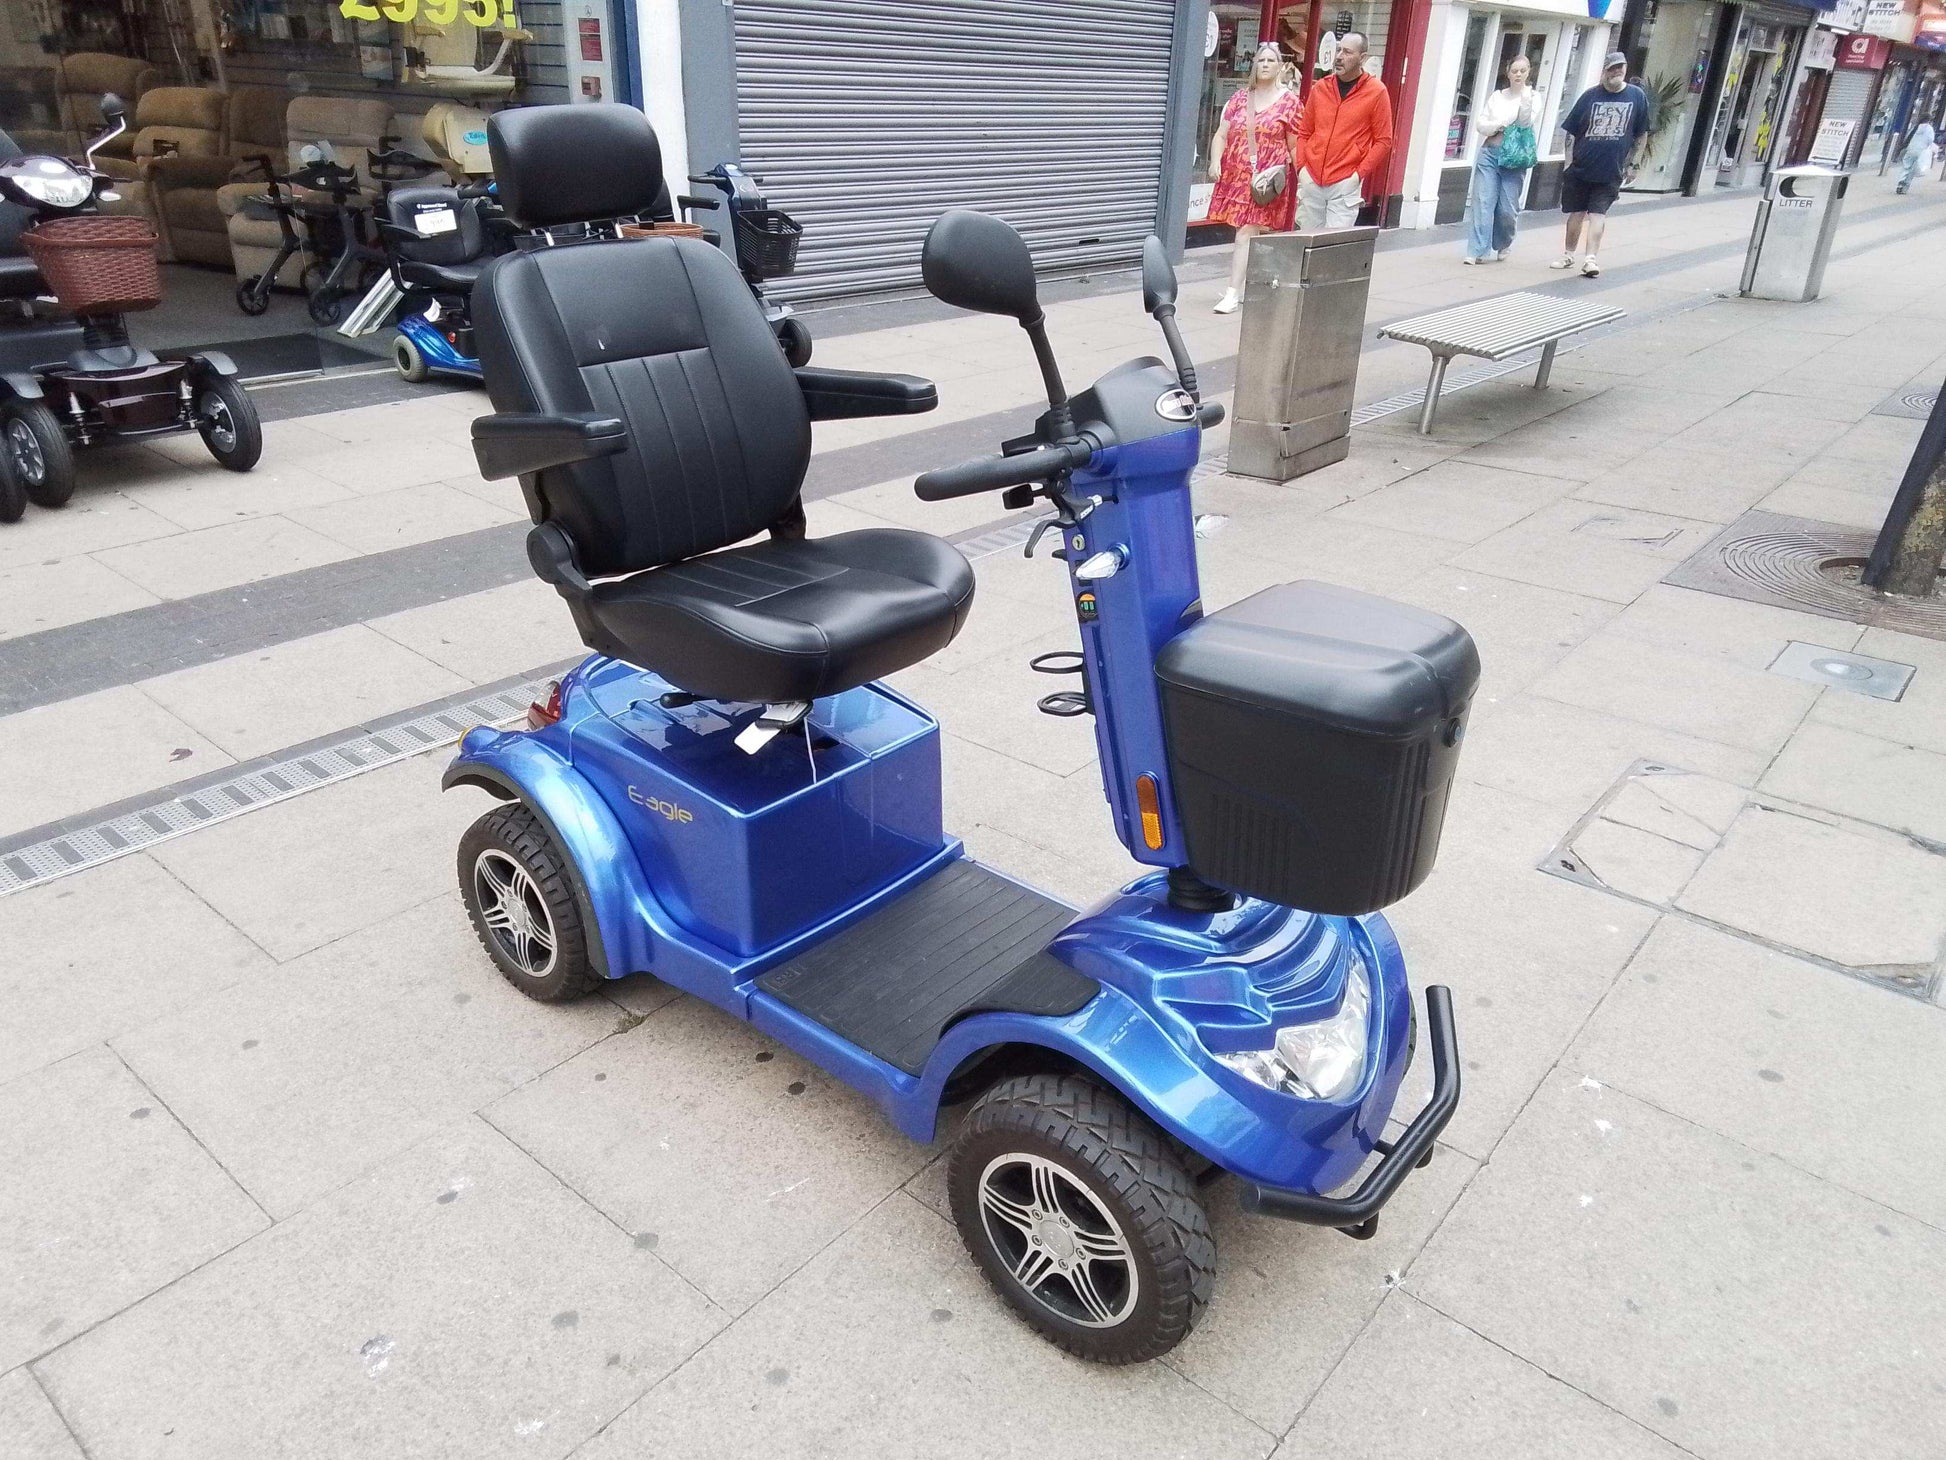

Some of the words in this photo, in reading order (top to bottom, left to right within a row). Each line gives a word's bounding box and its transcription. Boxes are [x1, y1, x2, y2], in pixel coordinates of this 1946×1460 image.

[1821, 128, 1849, 137] STITCH
[1779, 199, 1813, 208] LITTER
[628, 785, 693, 824] Eagle
